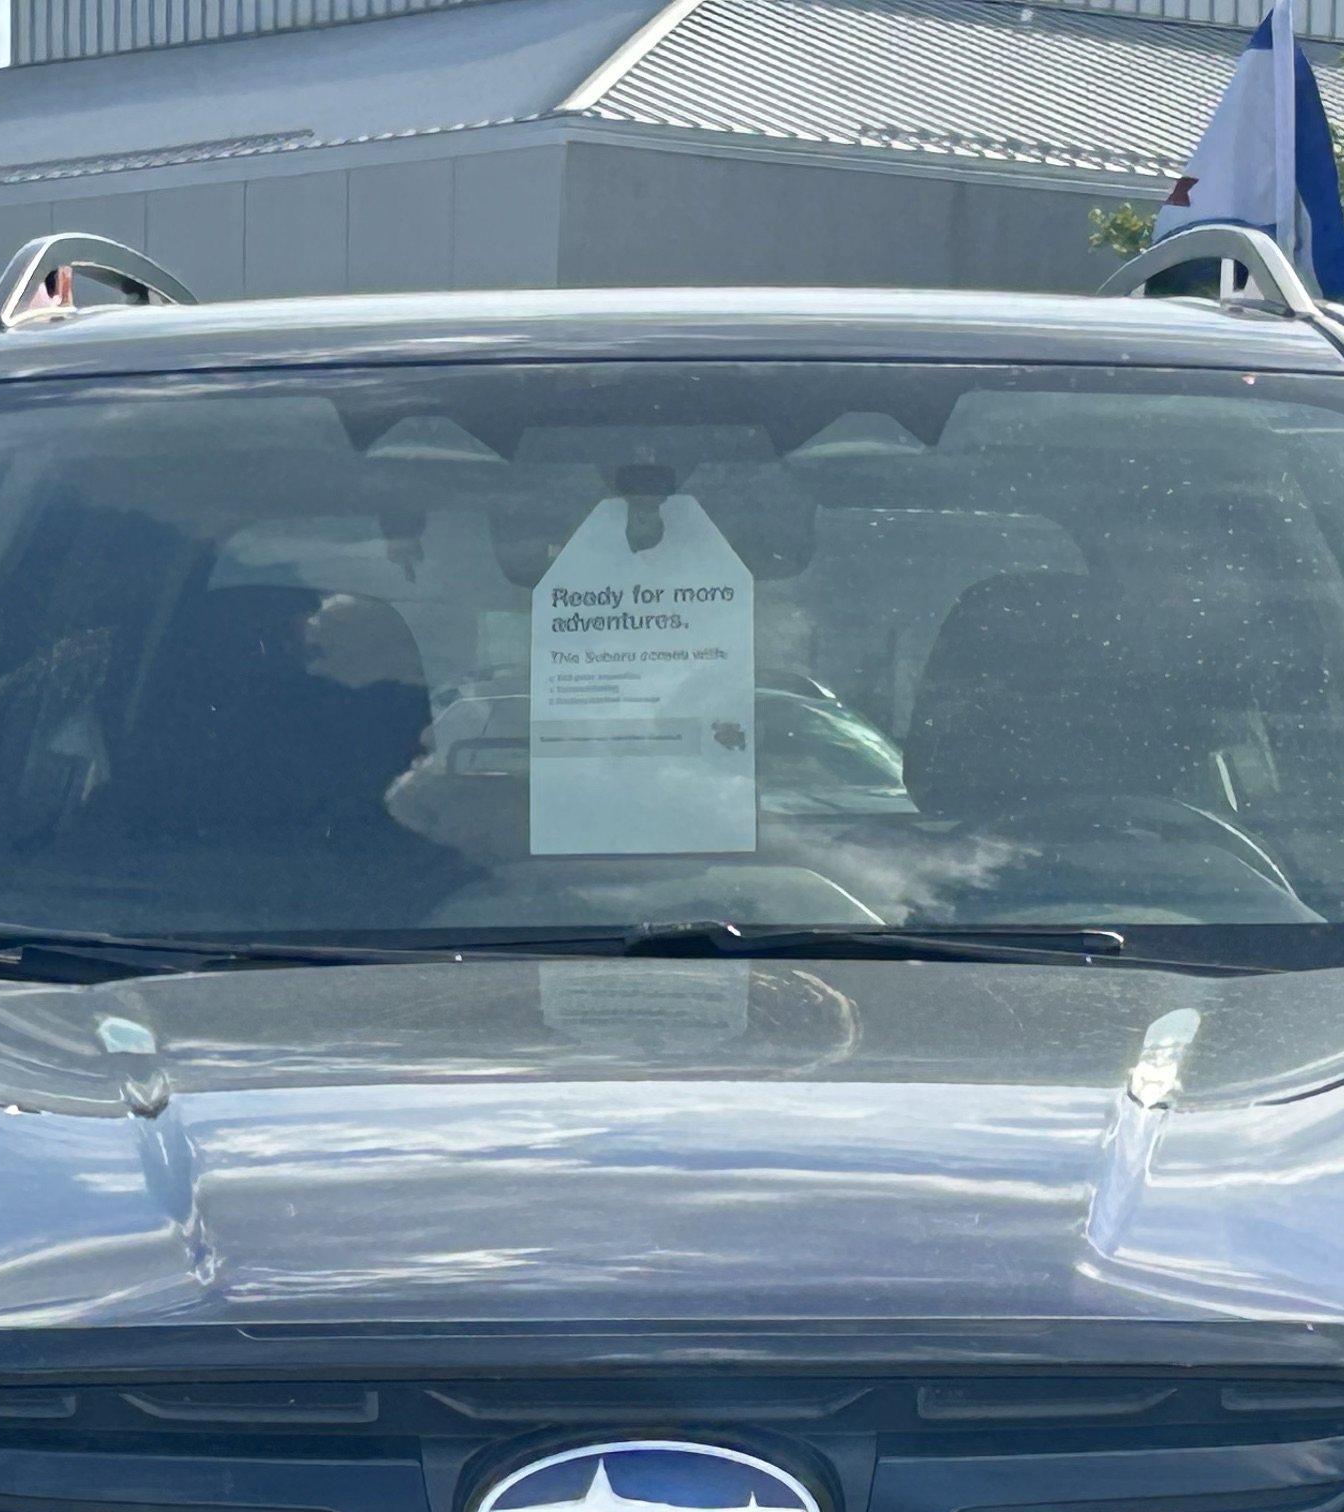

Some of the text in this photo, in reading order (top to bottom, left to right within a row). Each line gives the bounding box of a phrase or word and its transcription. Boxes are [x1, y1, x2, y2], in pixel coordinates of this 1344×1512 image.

[552, 584, 735, 609] Ready for more
[551, 612, 689, 633] adventures.
